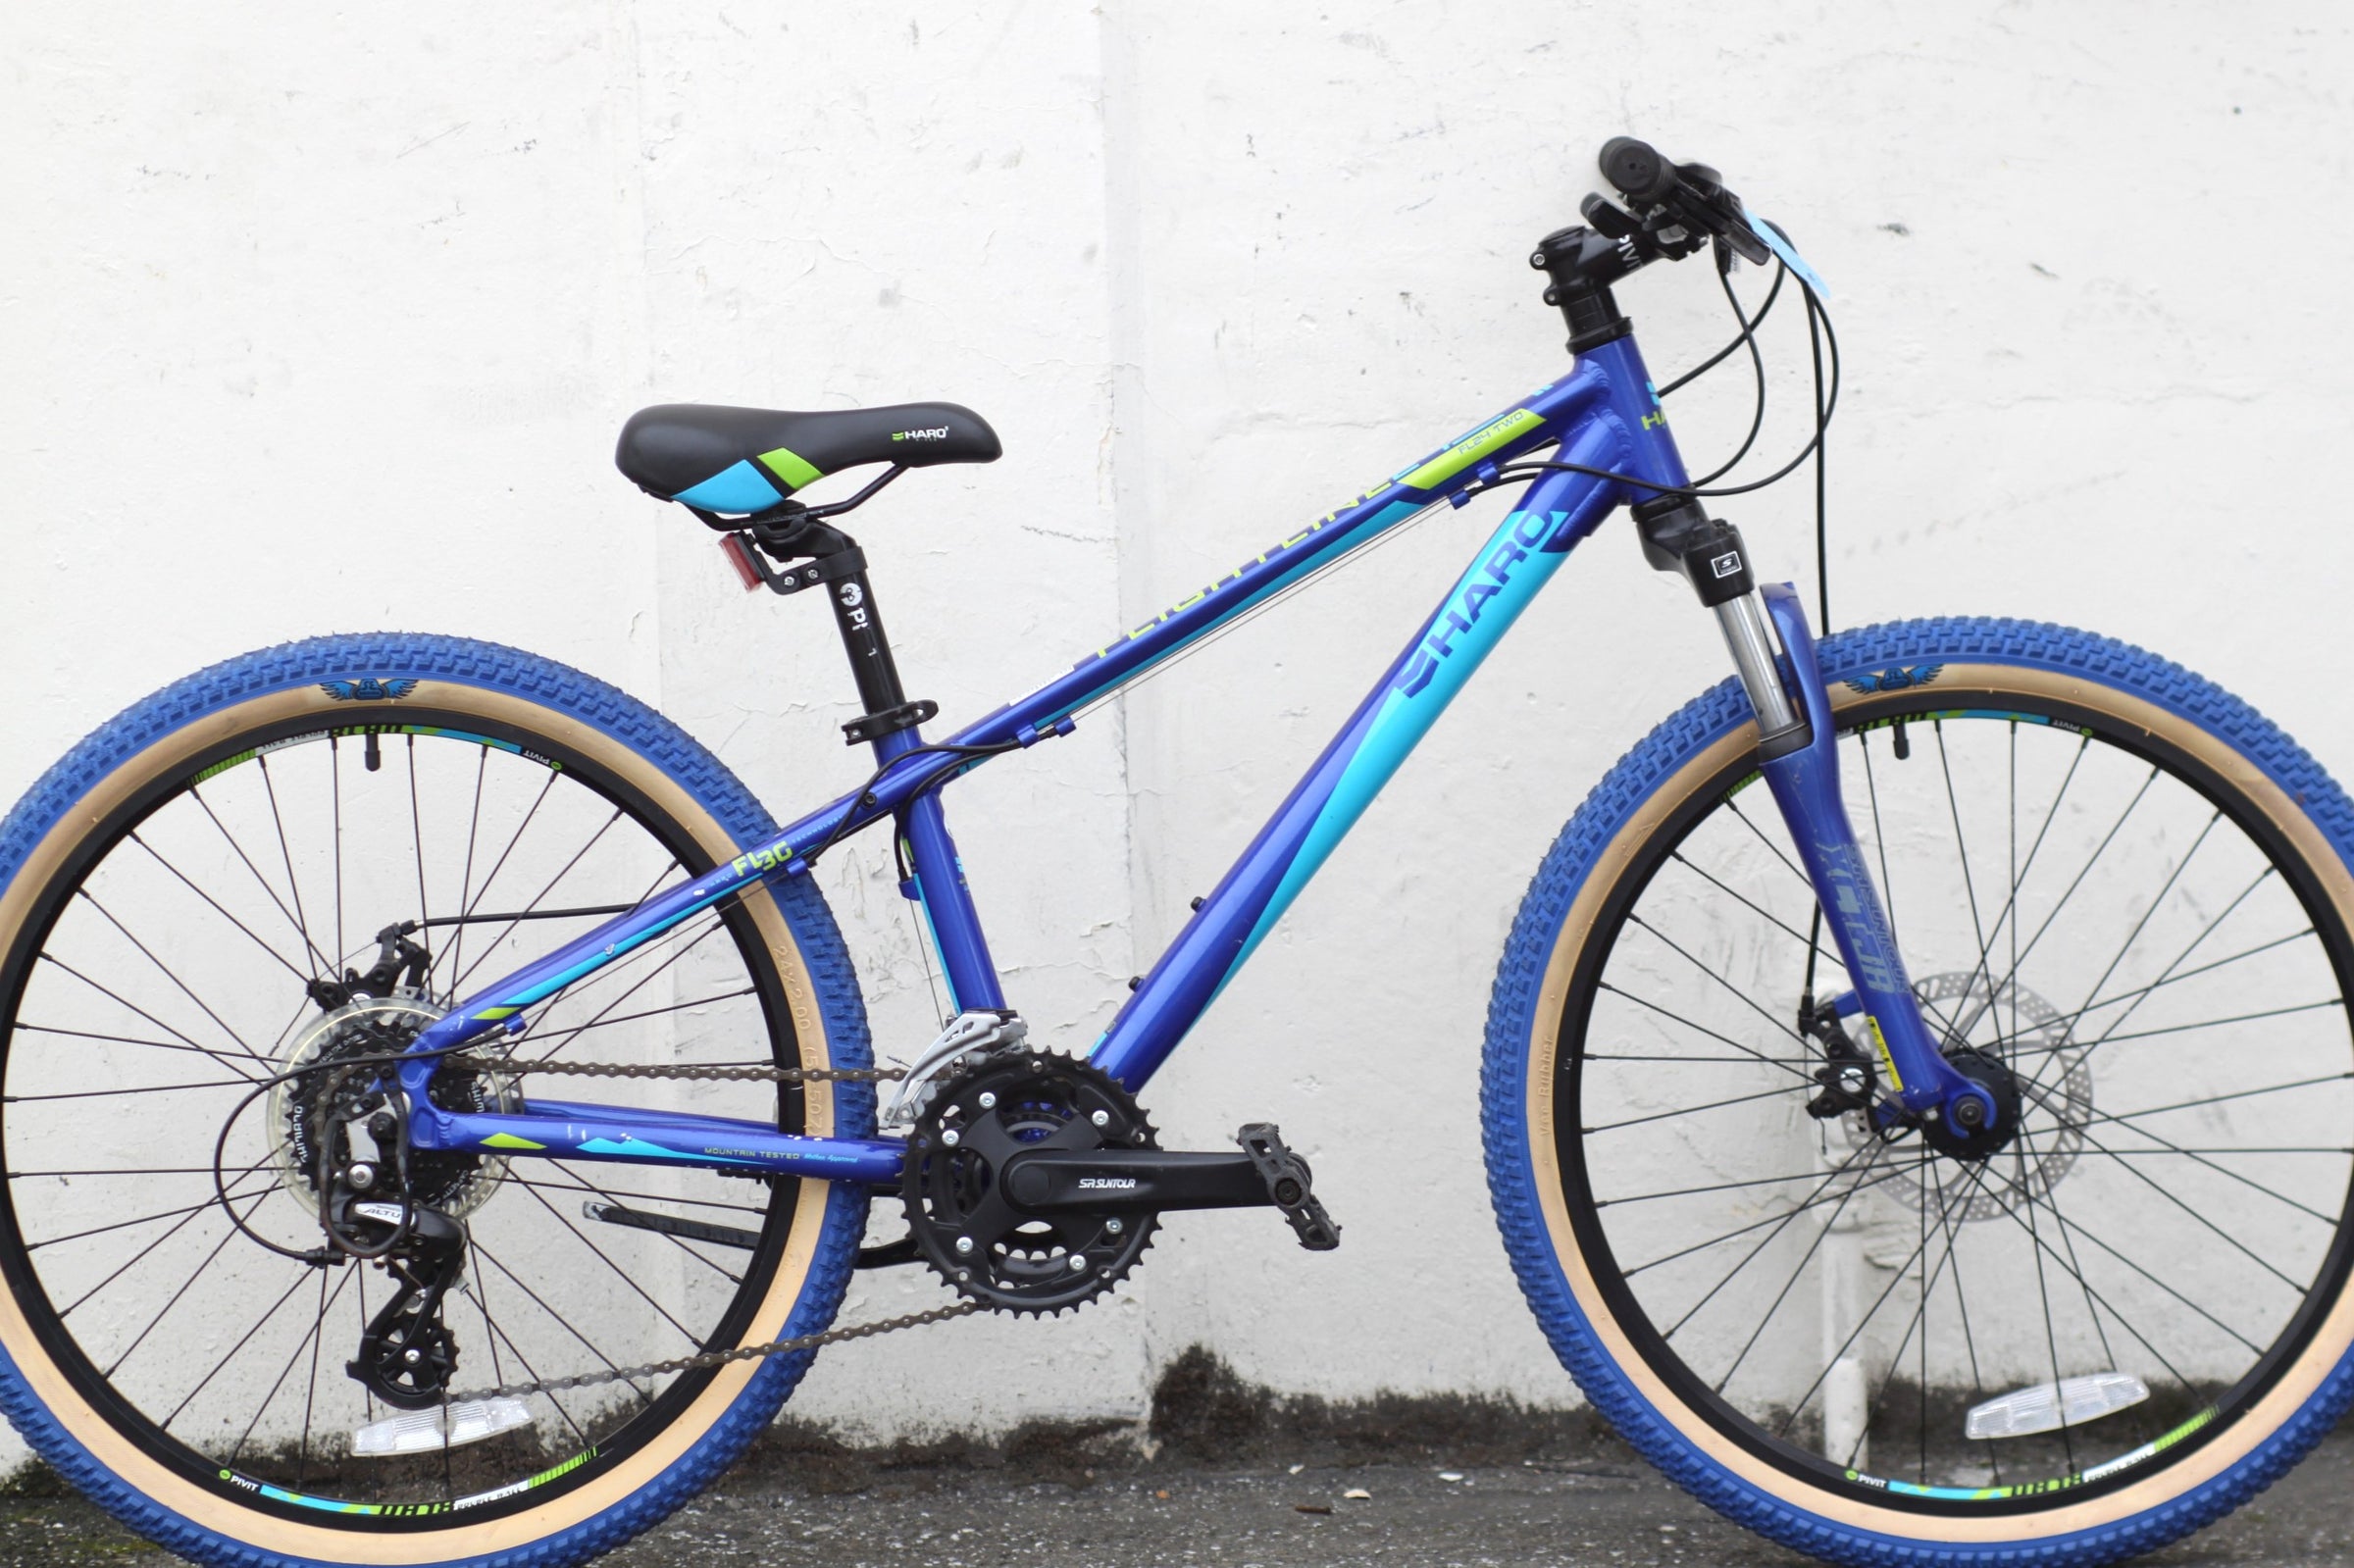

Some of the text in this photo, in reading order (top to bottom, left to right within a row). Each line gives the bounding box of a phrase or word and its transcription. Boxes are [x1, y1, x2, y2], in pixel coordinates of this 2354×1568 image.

[904, 428, 948, 439] HARO
[1458, 411, 1523, 454] FL24 TWO
[1426, 509, 1554, 658] HARO
[523, 750, 549, 765] PIVIT
[471, 1081, 486, 1113] SHIM
[293, 1105, 308, 1163] SHIMANO
[704, 1147, 755, 1157] MOUNTAIN
[760, 1150, 799, 1160] TESTED
[1079, 1179, 1136, 1189] SR SUNTOUR
[364, 1208, 401, 1218] ALTU
[230, 1475, 259, 1491] PIVIT
[1858, 1474, 1886, 1489] PIVIT
